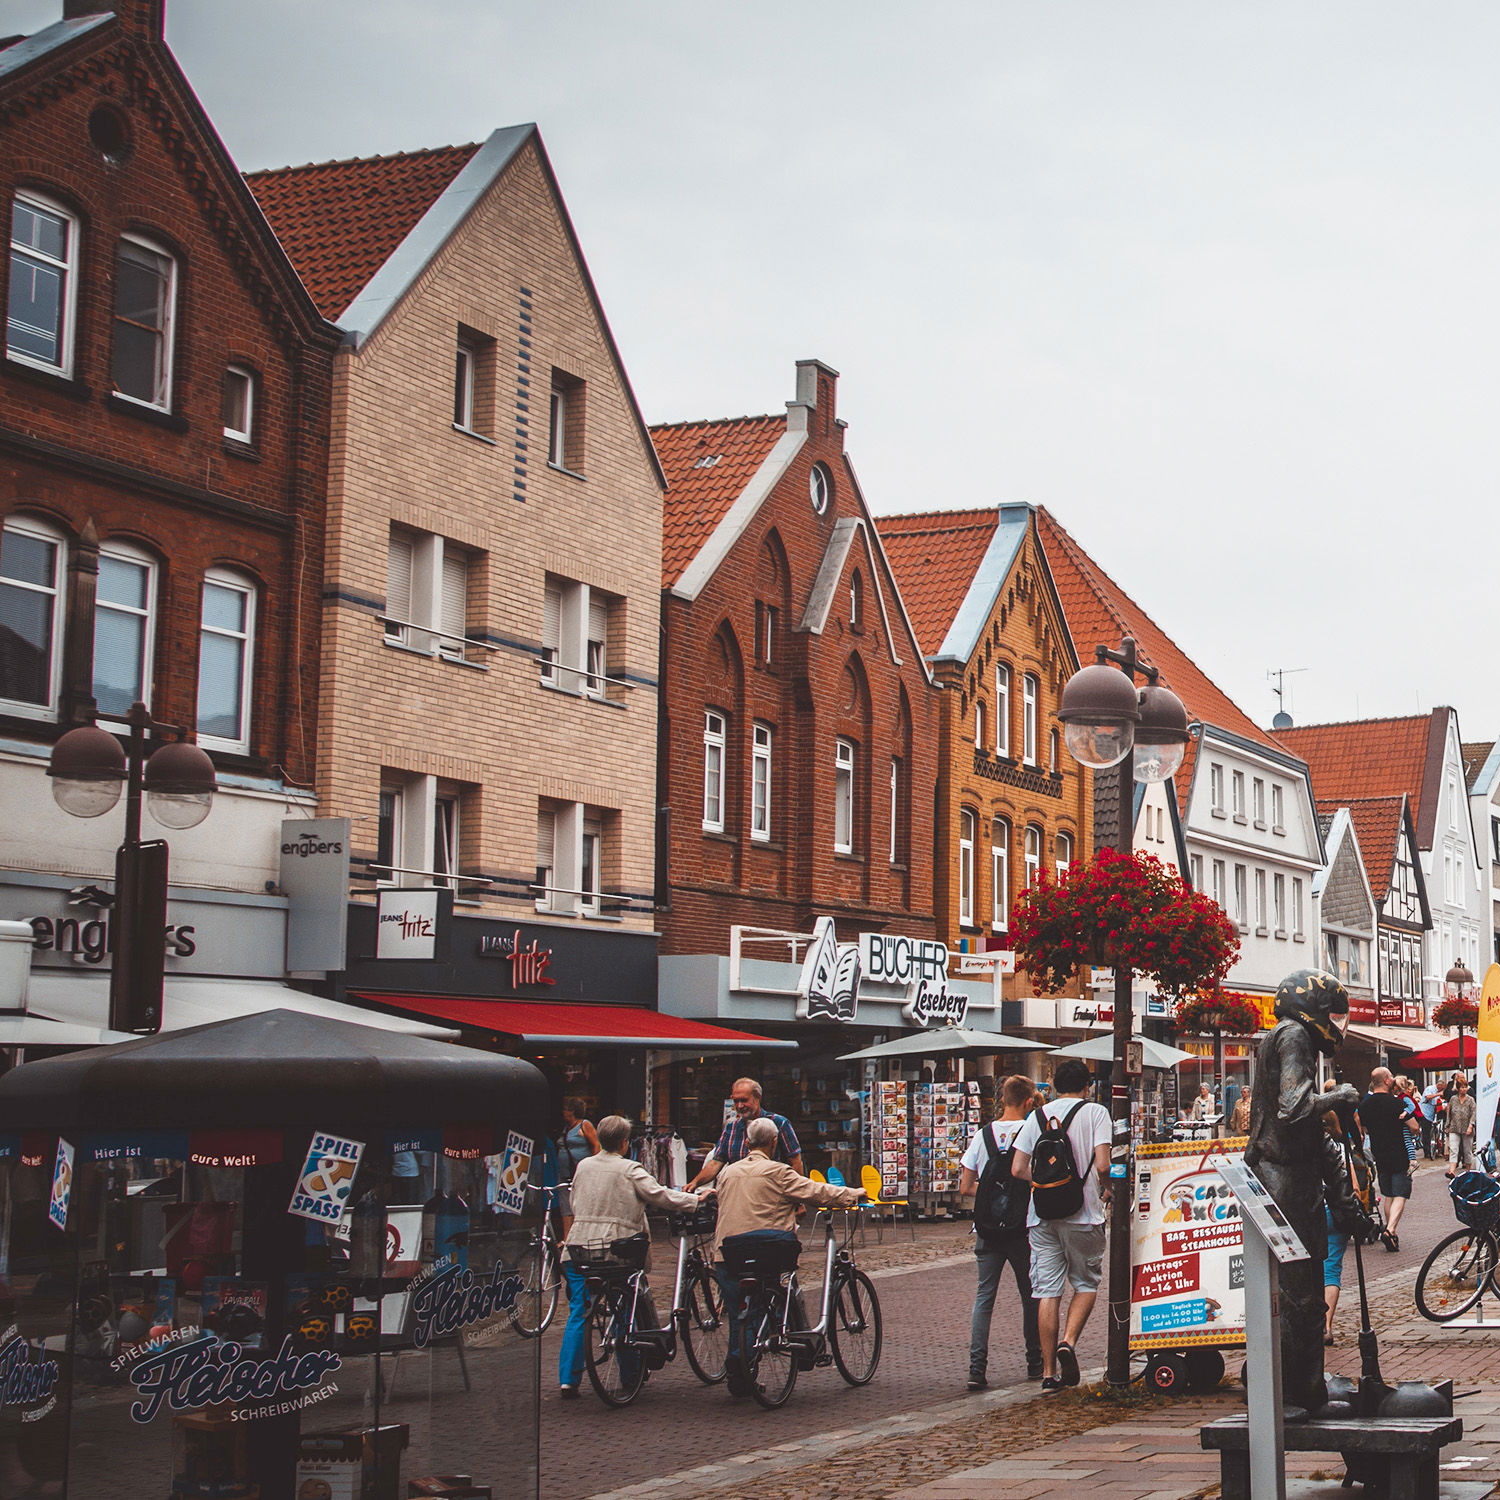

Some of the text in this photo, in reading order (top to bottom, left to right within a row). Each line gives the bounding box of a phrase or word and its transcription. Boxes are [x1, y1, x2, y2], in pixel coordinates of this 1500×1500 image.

[281, 839, 342, 858] engbers
[380, 911, 435, 940] JEANS fritz
[506, 929, 557, 989] fritz
[869, 935, 947, 982] BÜCHER
[913, 980, 968, 1022] Leseberg
[95, 1145, 142, 1159] Hier ist
[313, 1135, 359, 1160] SPIEL
[394, 1140, 421, 1151] Hier ist
[444, 1146, 480, 1159] eure Welt!
[507, 1134, 532, 1155] SPIEL
[191, 1153, 257, 1166] eure Welt!
[291, 1195, 342, 1220] SPASS
[497, 1189, 523, 1210] SPASS
[1163, 1203, 1244, 1224] MEXICA
[1166, 1231, 1189, 1243] BAR,
[1193, 1223, 1244, 1238] RESTAURA
[1181, 1235, 1242, 1252] STEAKHOUSE
[403, 1254, 452, 1294] PIELWAREN
[1142, 1259, 1189, 1275] Mittags-
[1150, 1271, 1183, 1284] aktion
[1141, 1279, 1195, 1297] 12-14 Uhr
[1153, 1320, 1164, 1328] und
[1193, 1315, 1204, 1323] Uhr
[110, 1325, 200, 1372] SPIELWAREN
[130, 1333, 343, 1424] Fleischer
[230, 1381, 340, 1422] SCHREIBWAREN
